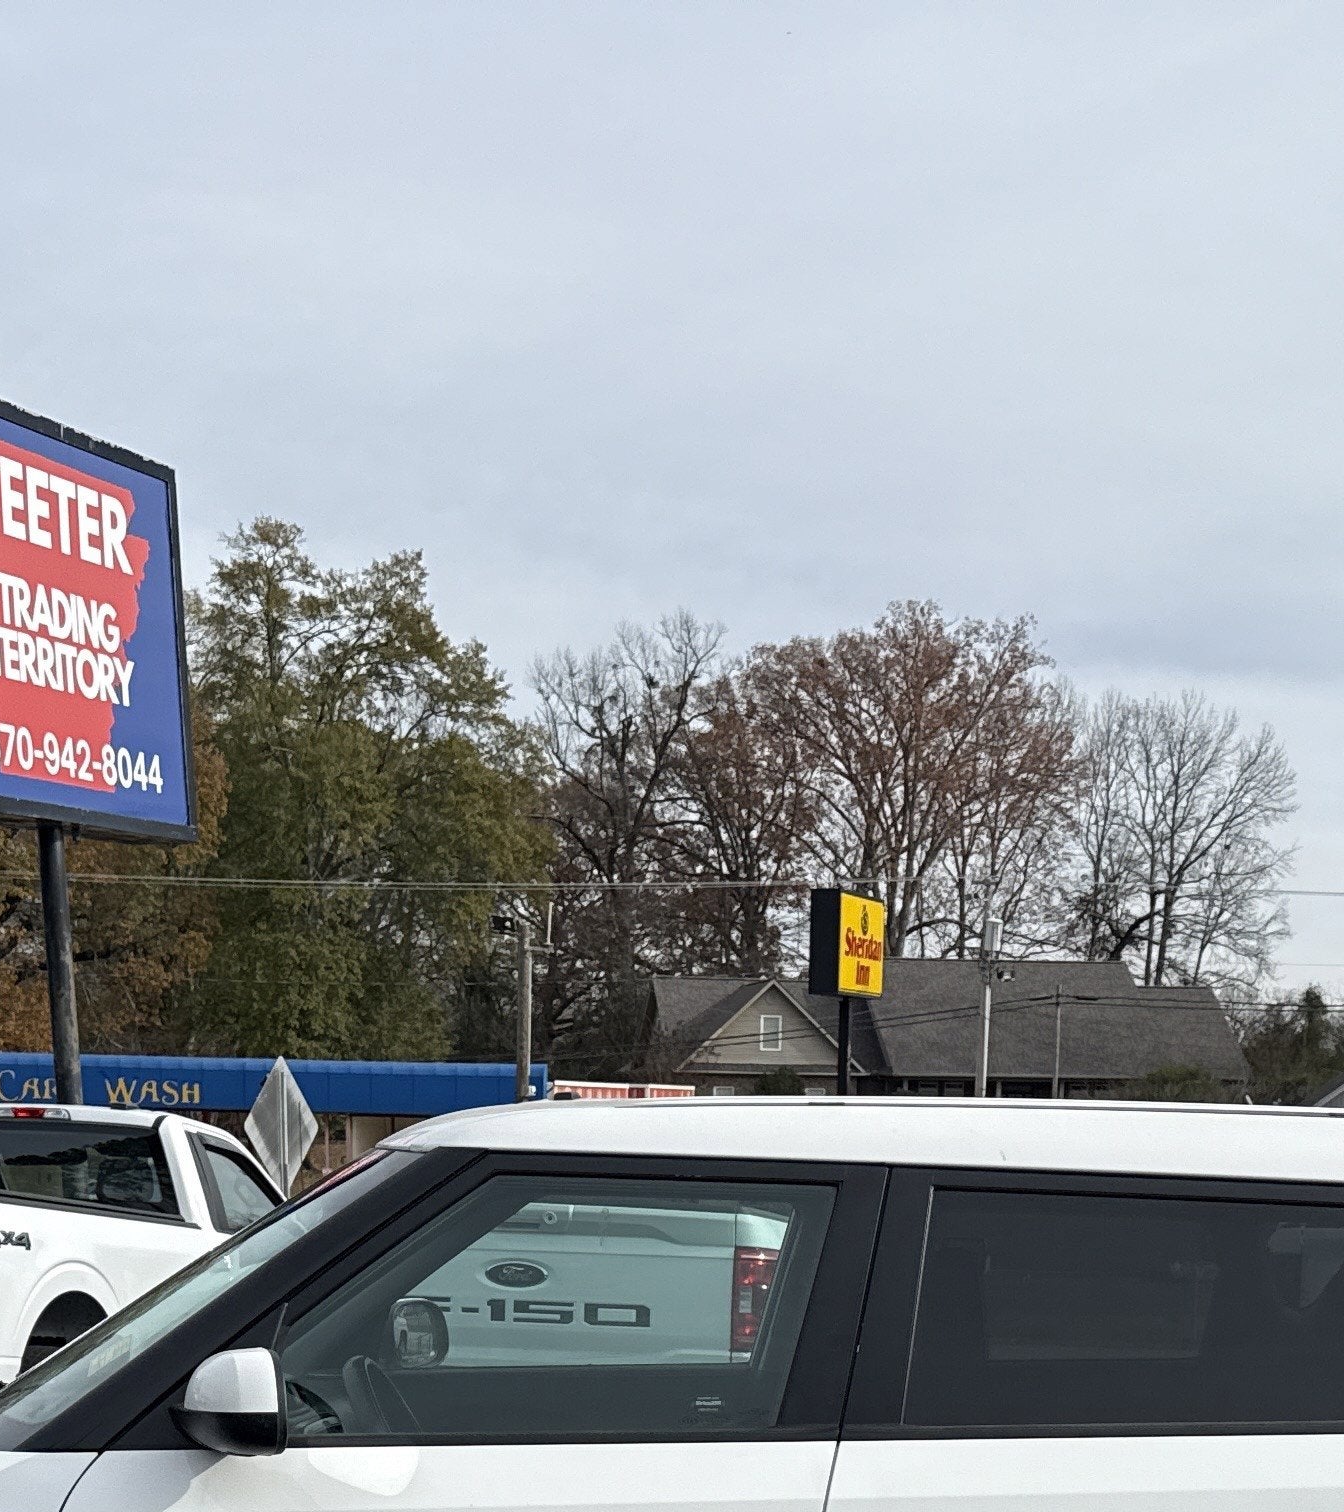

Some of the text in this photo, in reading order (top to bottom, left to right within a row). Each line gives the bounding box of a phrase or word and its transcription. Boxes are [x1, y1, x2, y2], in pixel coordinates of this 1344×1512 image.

[844, 926, 882, 962] Sheridan
[855, 960, 870, 986] Inn
[105, 1076, 200, 1106] WASH
